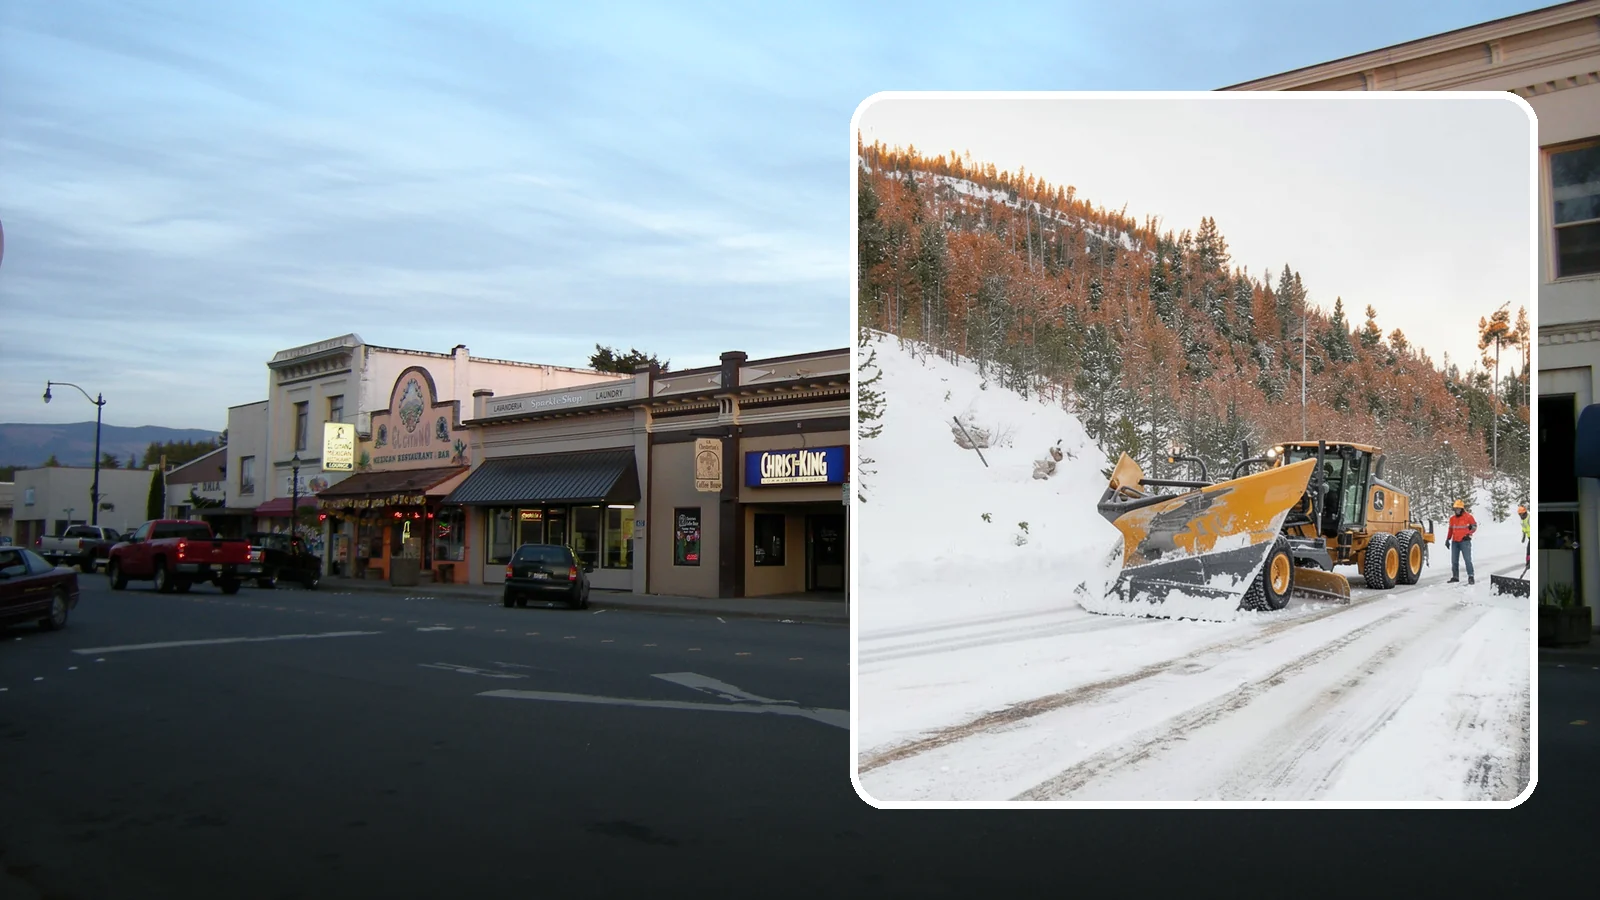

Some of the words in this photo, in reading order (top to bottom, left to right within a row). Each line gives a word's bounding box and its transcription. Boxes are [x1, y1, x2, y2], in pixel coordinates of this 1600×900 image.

[595, 389, 624, 400] LAUNDRY
[493, 402, 523, 412] LAVANDERIA
[530, 397, 562, 409] Sparkle
[561, 395, 583, 404] Shop
[374, 455, 396, 464] MEXICAN
[397, 451, 433, 462] RESTAURANT
[438, 450, 450, 459] BAR
[761, 452, 798, 478] CHRIST
[799, 450, 828, 477] KING
